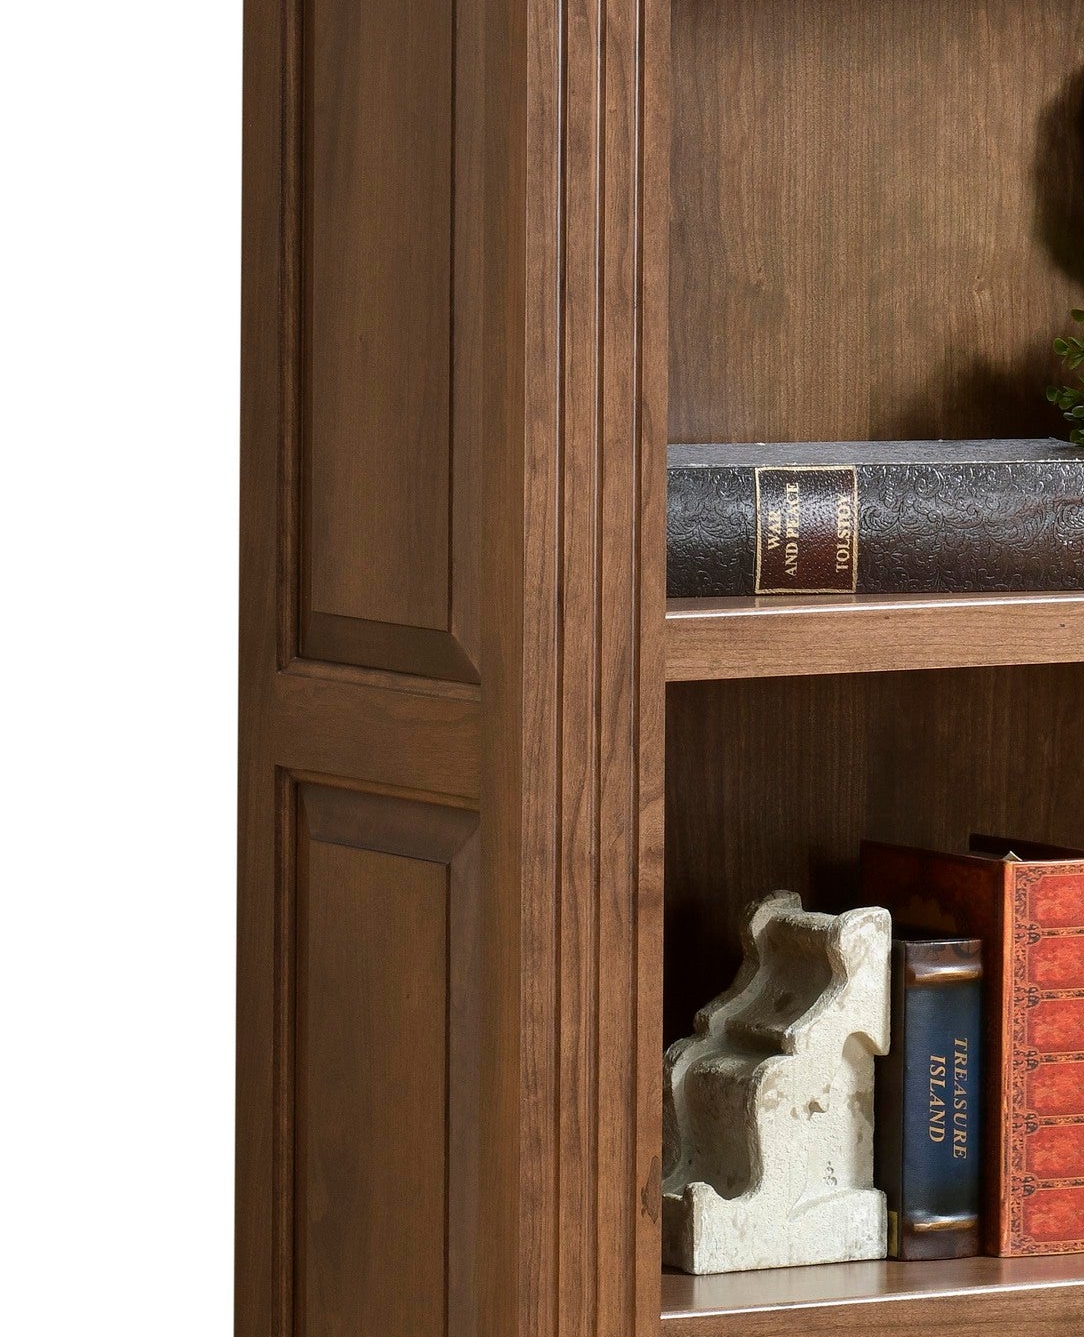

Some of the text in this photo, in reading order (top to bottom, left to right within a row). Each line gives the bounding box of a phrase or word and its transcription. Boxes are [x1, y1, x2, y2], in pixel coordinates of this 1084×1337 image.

[768, 510, 781, 550] WAR
[785, 482, 799, 577] AND PEACE
[836, 493, 852, 573] TOLSTOY
[929, 1054, 946, 1143] ISLAND
[953, 1038, 968, 1159] TREASURE
